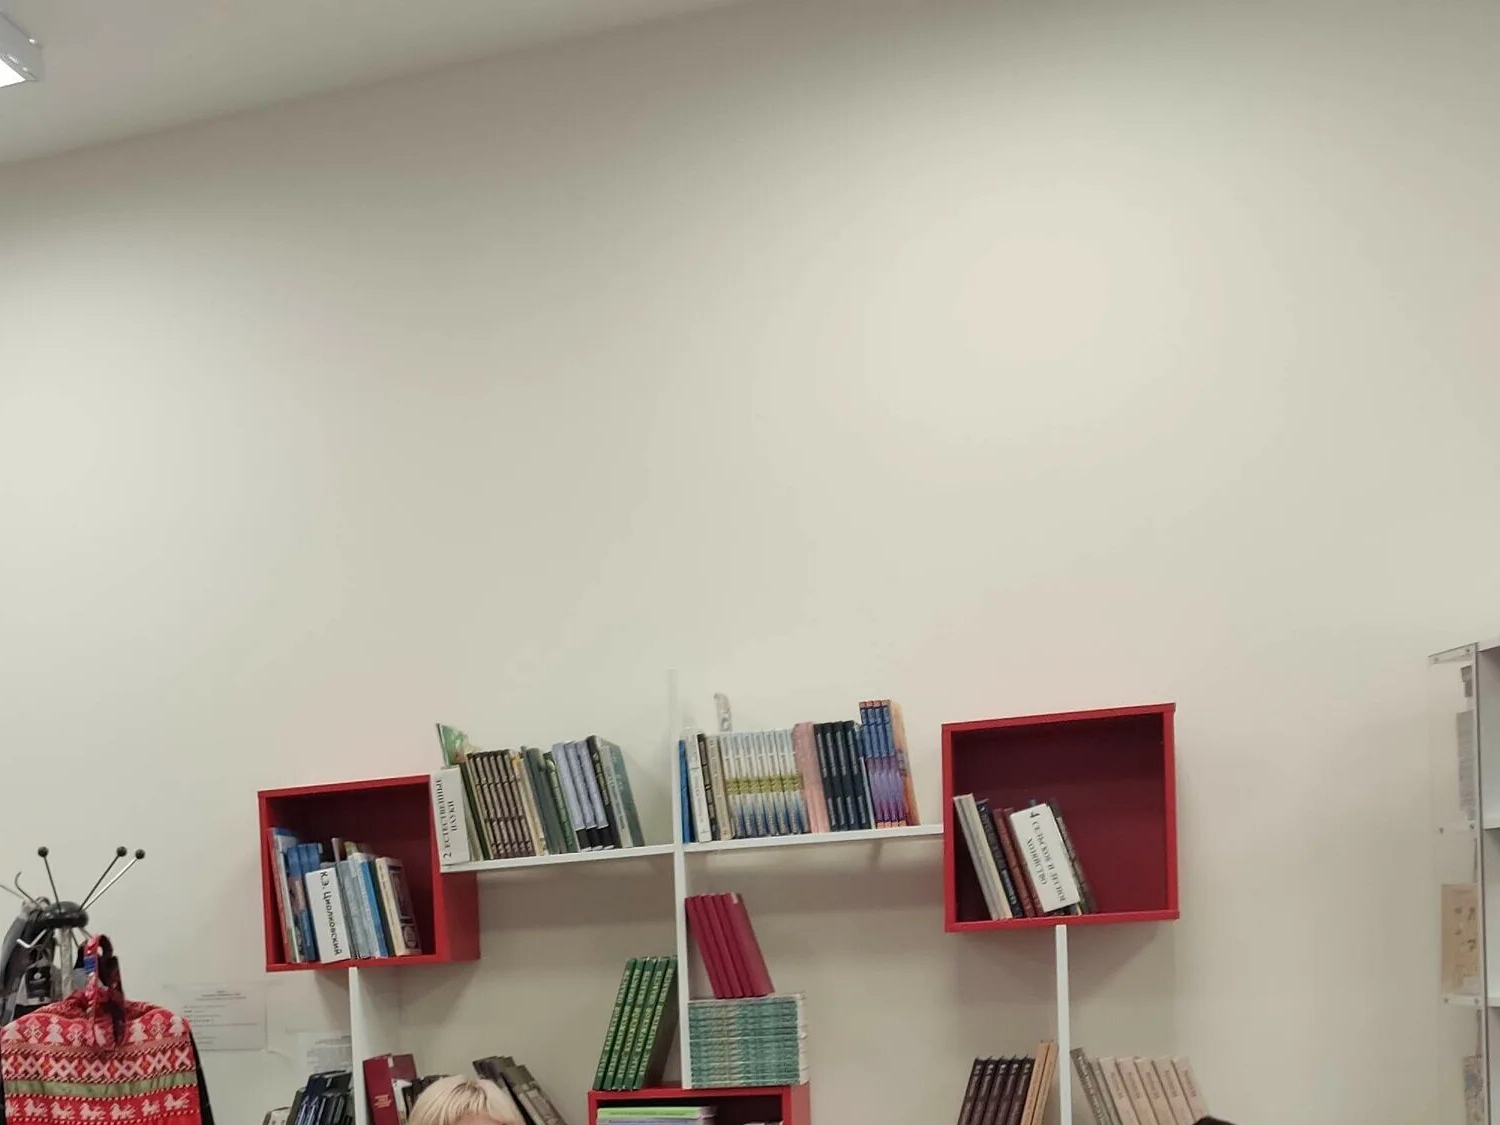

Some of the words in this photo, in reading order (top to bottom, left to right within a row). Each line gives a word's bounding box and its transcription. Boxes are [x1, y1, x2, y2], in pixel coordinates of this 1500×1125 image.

[435, 778, 452, 849] ЕСТЕСТВЕННЫЕ
[448, 800, 458, 832] НАУКИ
[322, 891, 343, 956] Циолковский
